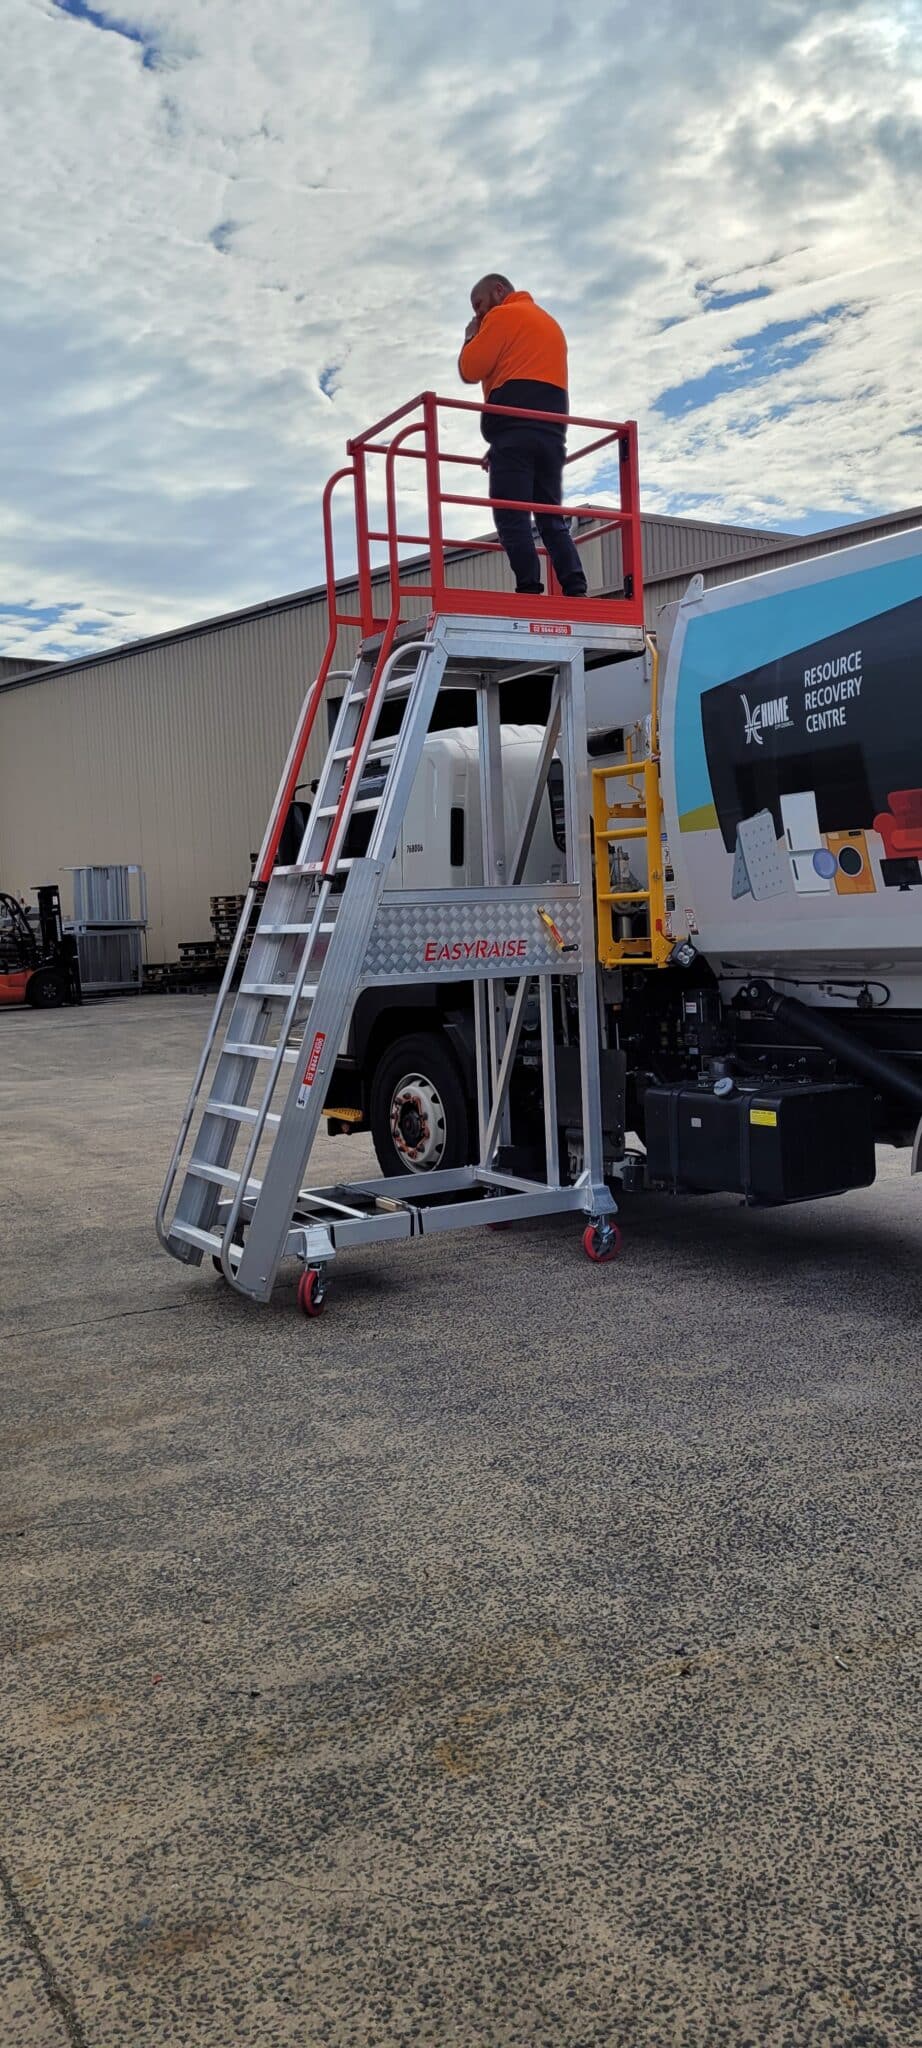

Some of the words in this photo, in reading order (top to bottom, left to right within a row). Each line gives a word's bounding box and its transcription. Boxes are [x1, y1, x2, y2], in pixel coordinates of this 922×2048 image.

[804, 651, 862, 688] RESOURCE
[805, 676, 863, 711] RECOVERY
[761, 696, 789, 728] HUME
[806, 706, 847, 733] CENTRE
[424, 940, 528, 961] EASYRAISE
